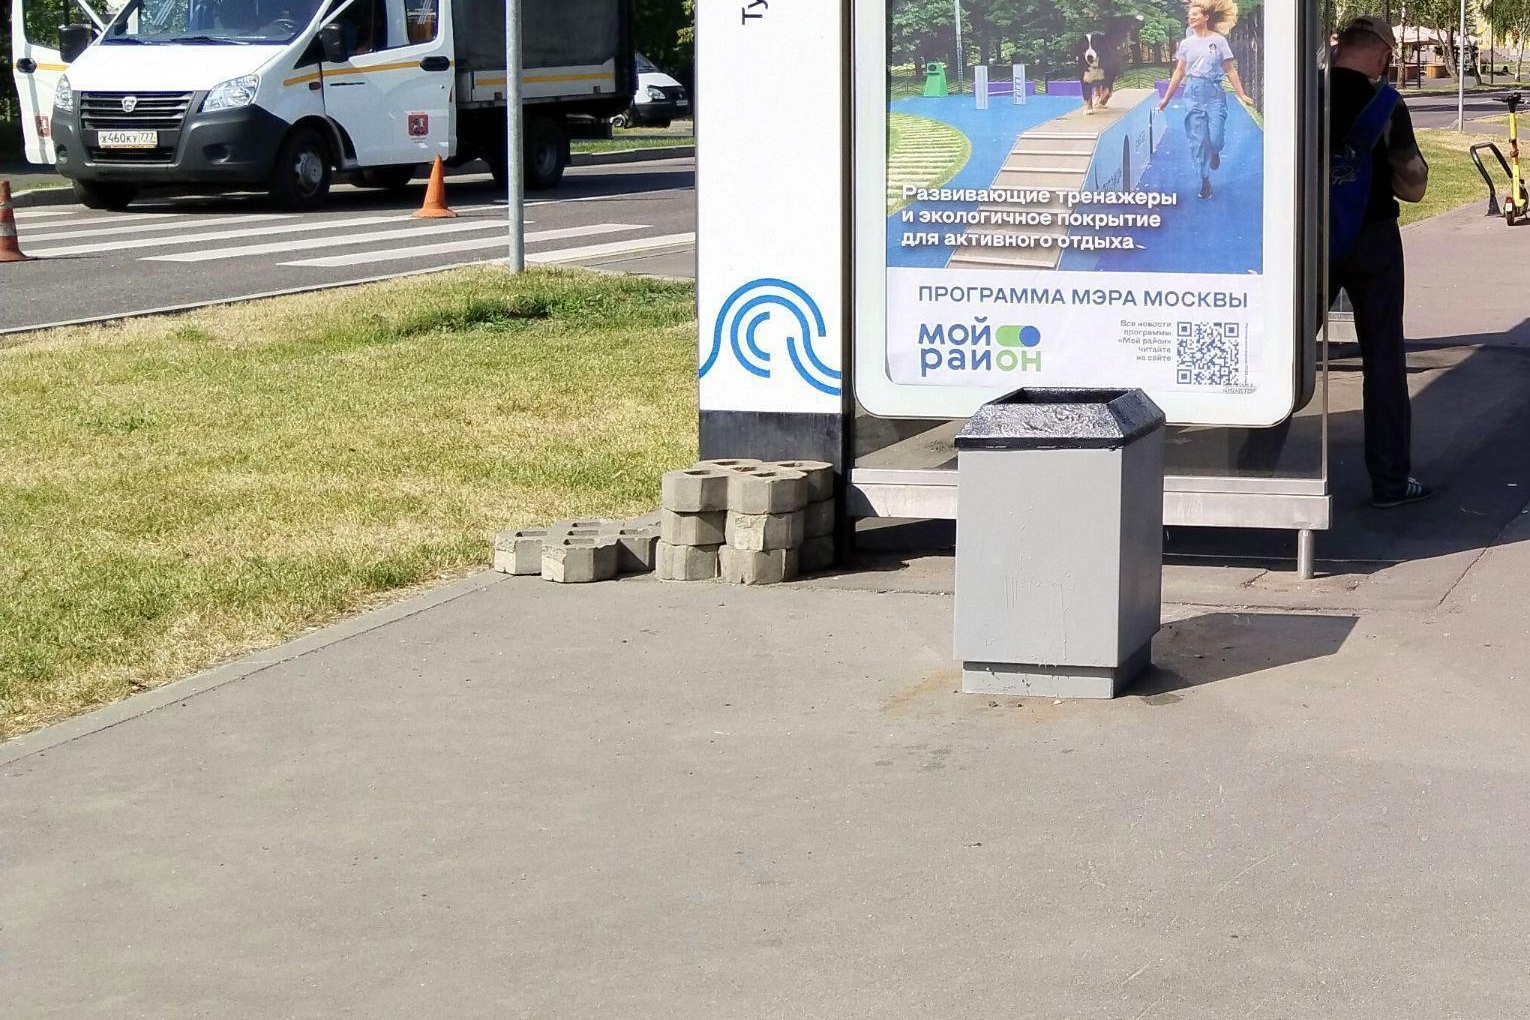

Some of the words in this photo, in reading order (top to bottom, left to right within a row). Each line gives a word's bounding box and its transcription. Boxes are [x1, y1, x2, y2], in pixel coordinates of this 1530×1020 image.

[901, 184, 1051, 205] Развивающие
[1056, 188, 1178, 208] тренажеры
[902, 210, 914, 223] и
[919, 210, 1052, 226] экологичное
[1057, 213, 1162, 231] покрытие
[901, 232, 940, 247] для
[944, 232, 1053, 249] активного
[1058, 235, 1135, 251] отдыха
[918, 285, 1066, 305] ПРОГРАММА
[1071, 288, 1138, 306] МЭРА
[1143, 290, 1248, 308] МОСКВЫ
[918, 315, 992, 347] мой
[1120, 319, 1136, 327] Все
[1124, 329, 1172, 337] программы
[1147, 353, 1172, 362] сайте
